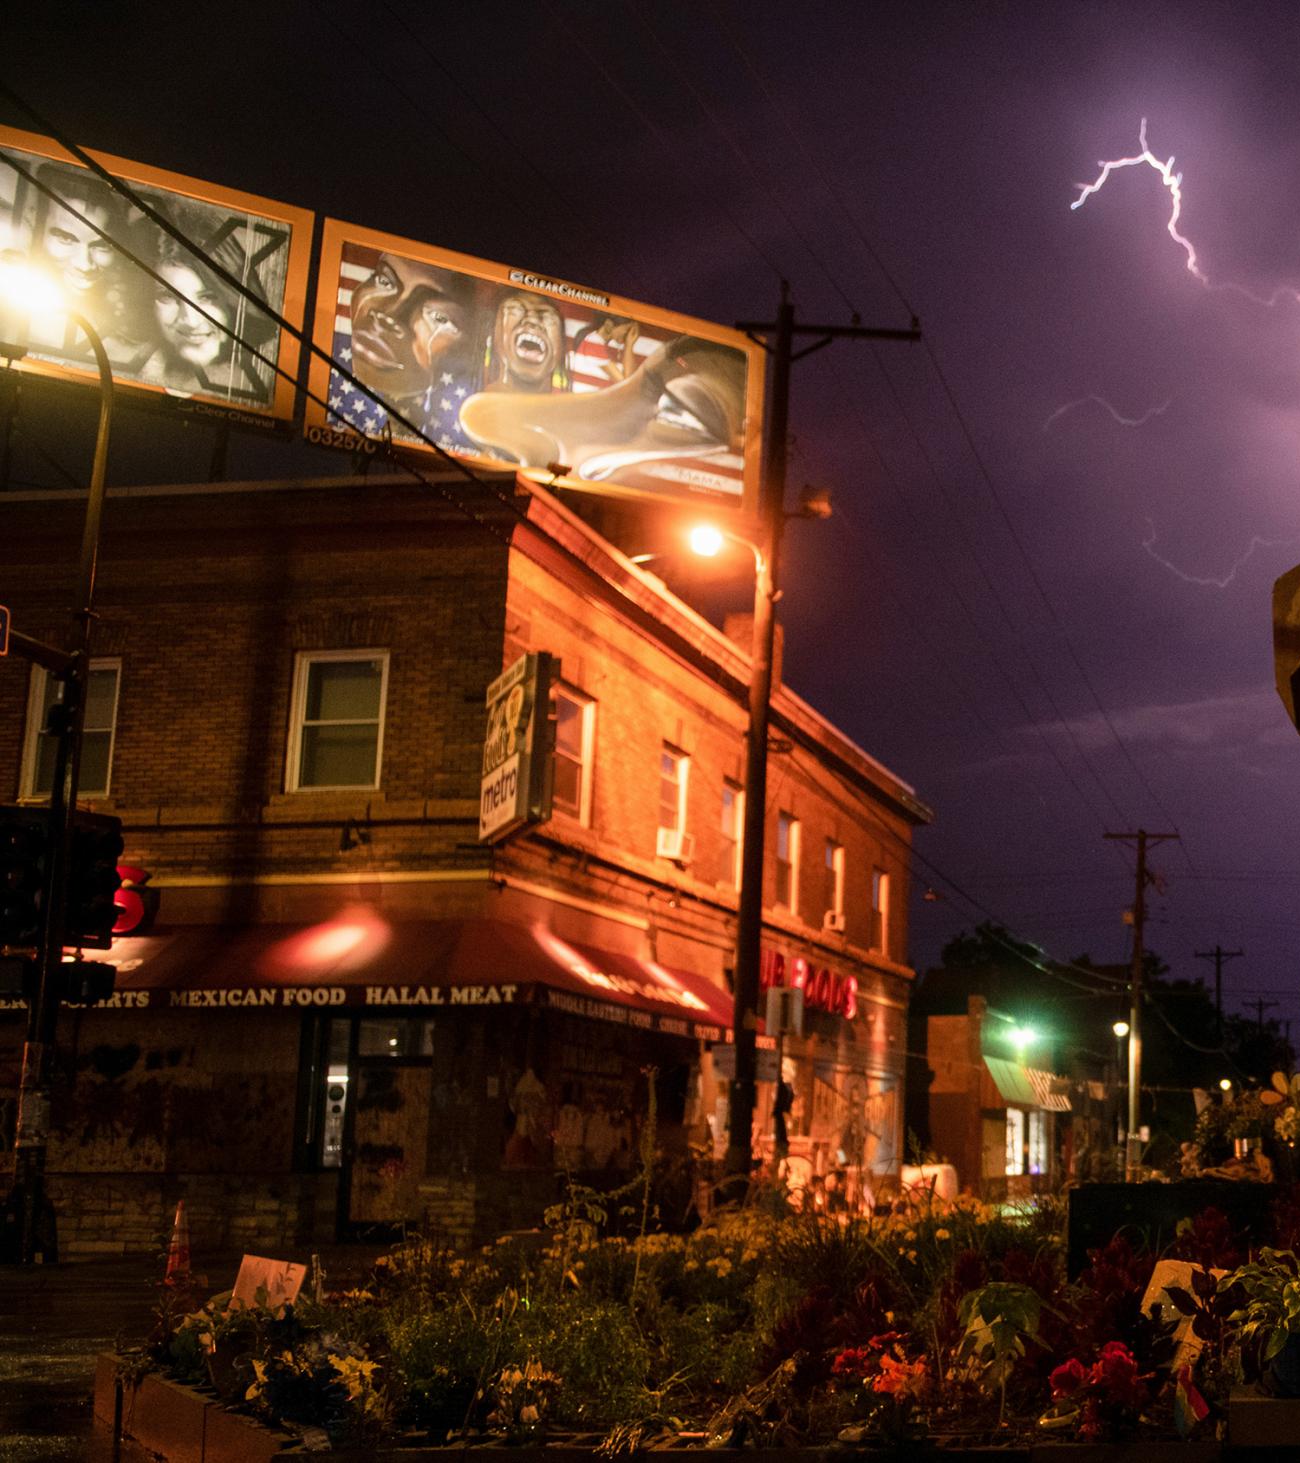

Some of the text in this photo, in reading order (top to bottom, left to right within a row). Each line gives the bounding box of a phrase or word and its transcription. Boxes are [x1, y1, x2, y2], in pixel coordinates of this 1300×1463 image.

[482, 766, 517, 816] metro
[169, 988, 277, 1007] MEXICAN
[282, 987, 346, 1006] FOOD
[365, 985, 444, 1005] HALAL
[450, 984, 517, 1004] MEAT
